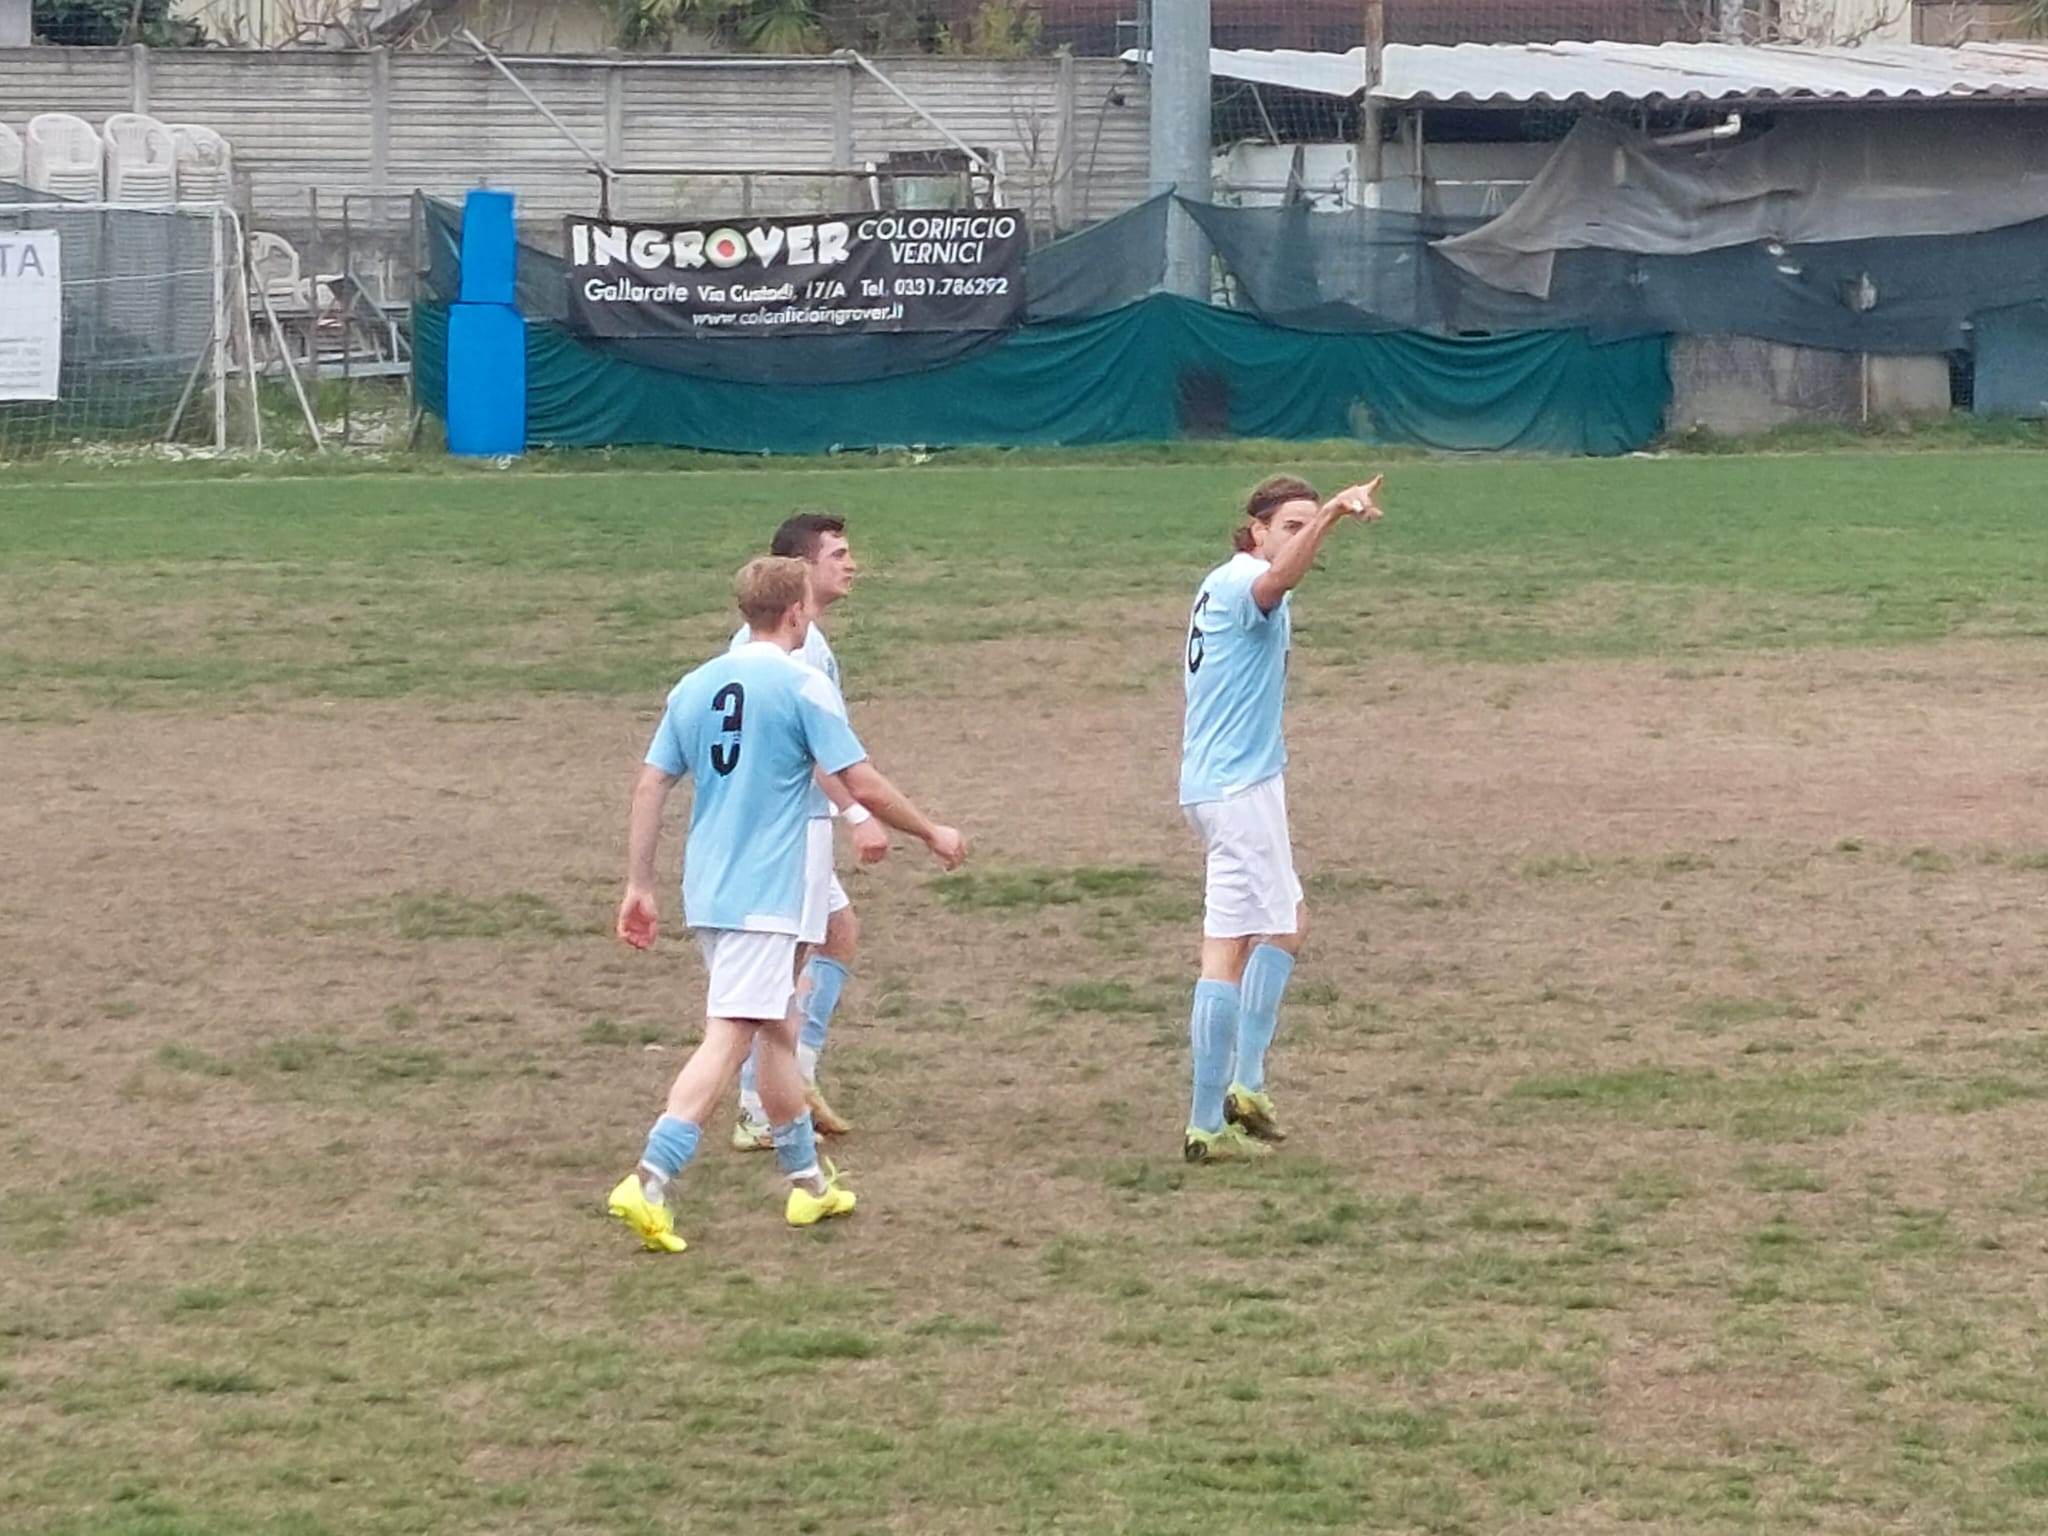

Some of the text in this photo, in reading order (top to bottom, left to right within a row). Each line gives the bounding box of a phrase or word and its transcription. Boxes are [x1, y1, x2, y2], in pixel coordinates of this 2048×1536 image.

[858, 217, 1016, 241] COLORIFICIO
[572, 223, 850, 270] INGROVER
[890, 242, 983, 264] VERNICI
[584, 277, 690, 302] Gallarate
[698, 284, 726, 302] Via
[894, 277, 1009, 297] 0331.786292
[711, 682, 745, 777] 3
